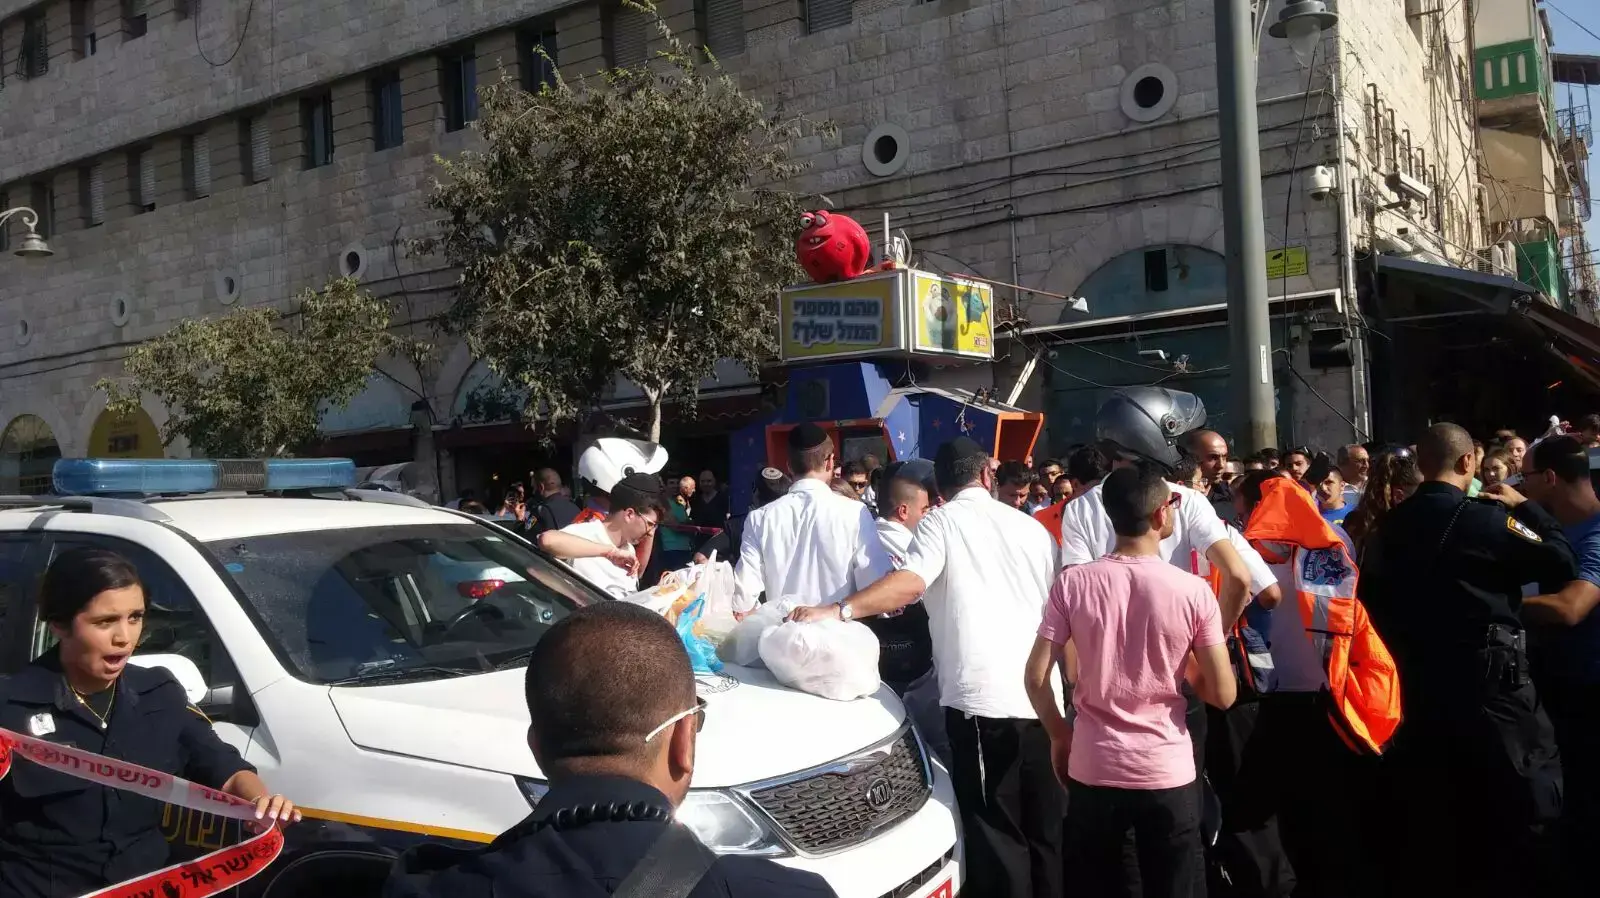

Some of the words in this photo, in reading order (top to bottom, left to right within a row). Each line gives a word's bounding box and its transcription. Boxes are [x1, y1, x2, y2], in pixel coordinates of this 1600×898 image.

[793, 300, 840, 316] מספרי
[843, 300, 879, 316] מהם
[792, 320, 834, 345] שלך?
[837, 320, 879, 341] המזל
[60, 753, 162, 788] משטרת
[872, 782, 892, 804] KIA
[180, 849, 254, 888] ישראל
